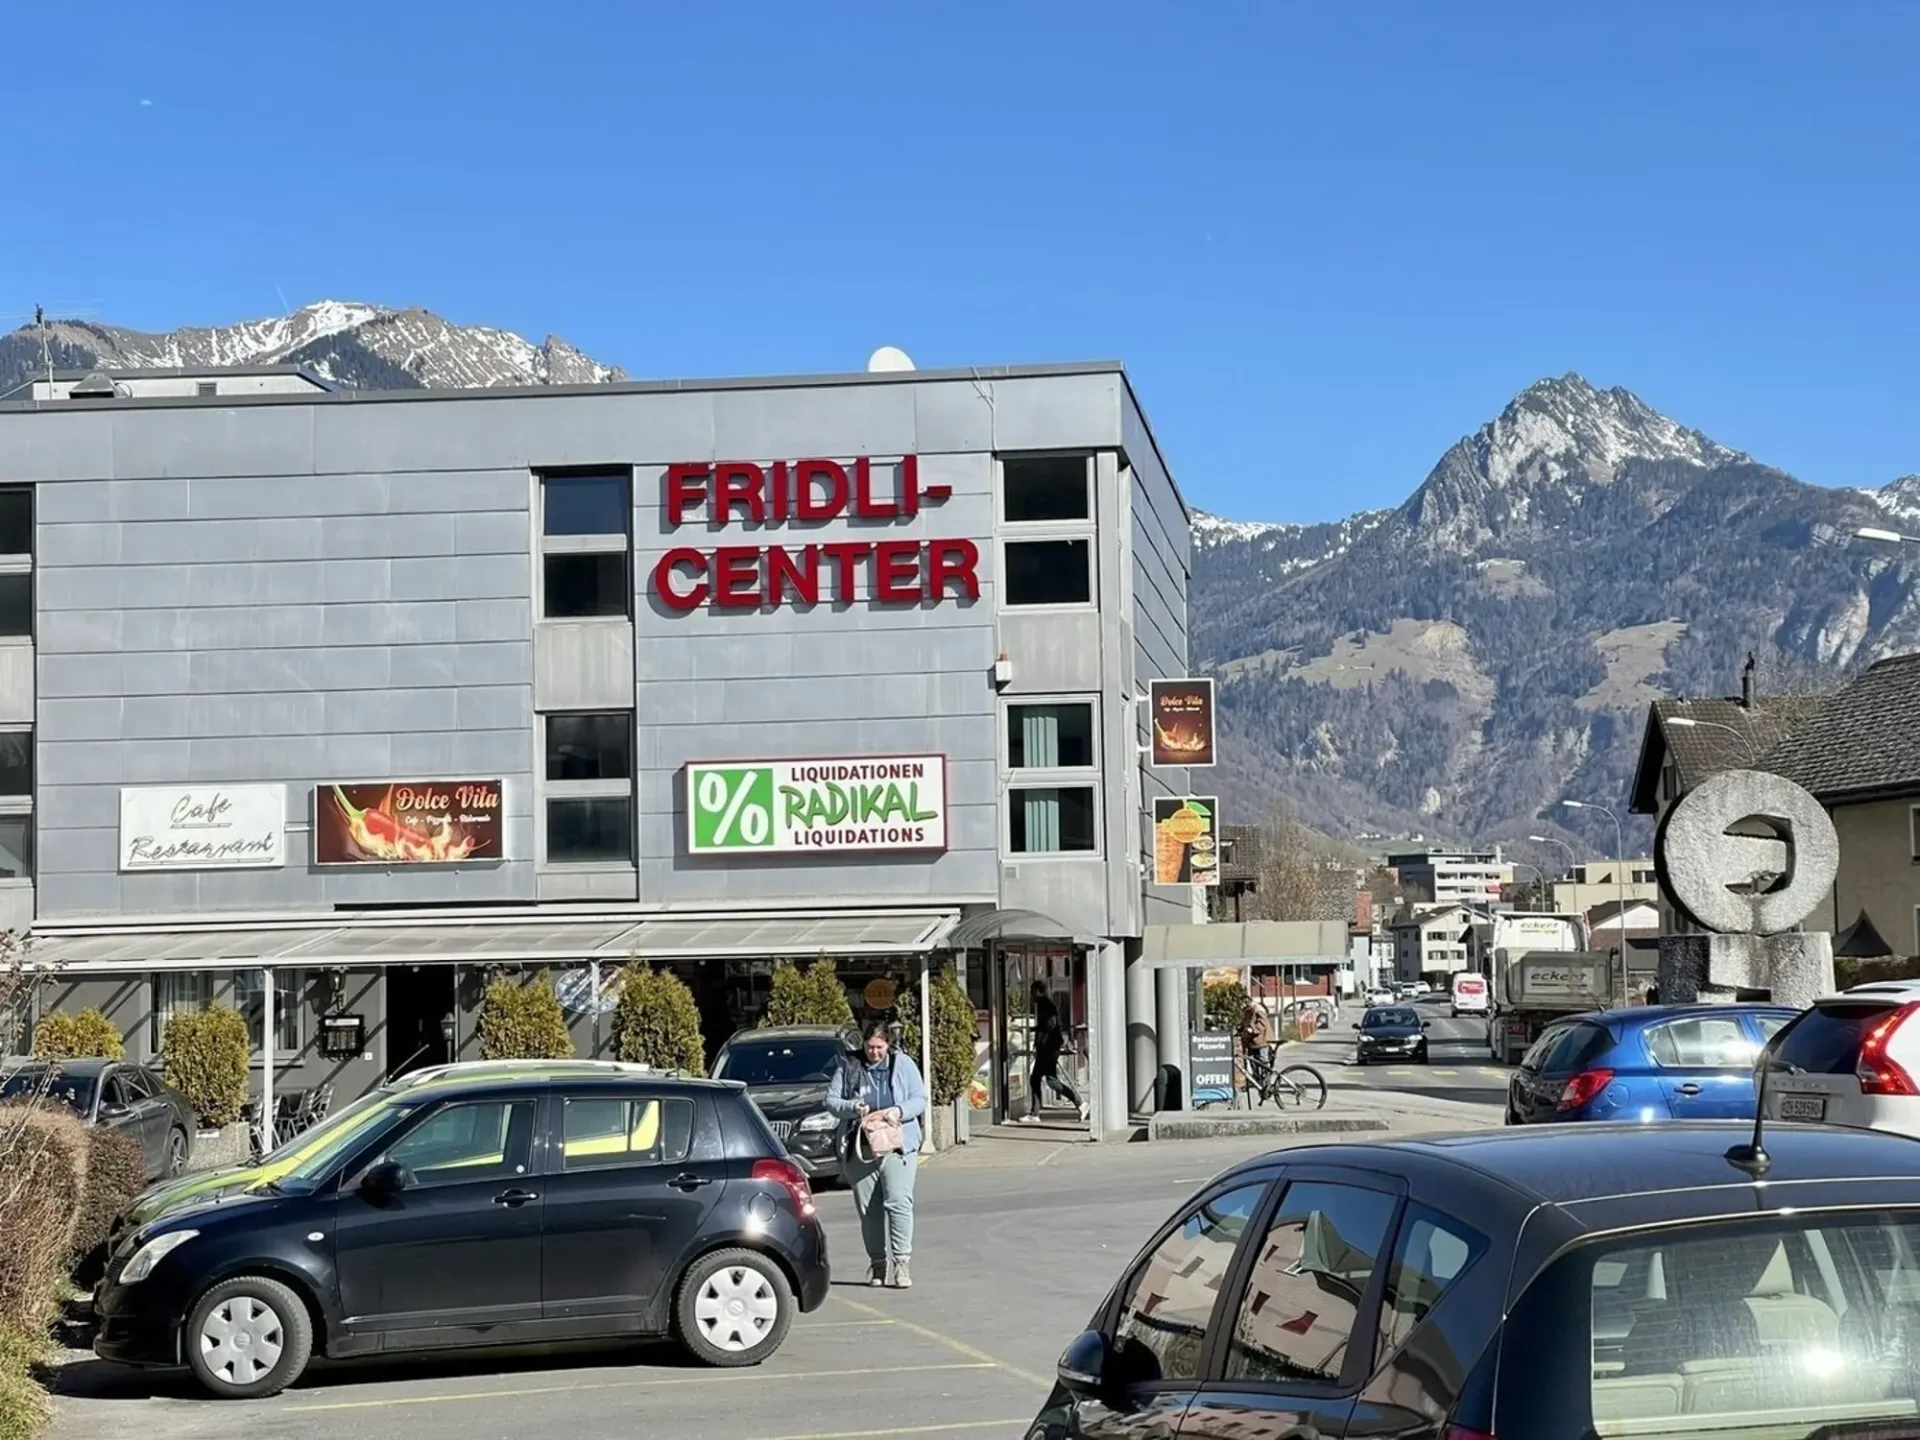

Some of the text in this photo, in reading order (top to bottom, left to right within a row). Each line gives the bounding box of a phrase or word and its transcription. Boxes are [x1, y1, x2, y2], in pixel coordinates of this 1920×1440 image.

[667, 454, 952, 525] FRIDLI-
[655, 538, 981, 610] CENTER
[791, 764, 924, 782] LIQUIDATIONEN
[396, 785, 500, 811] Dolce Vita
[779, 781, 938, 829] RADIKAL
[129, 831, 274, 861] Restaurant
[794, 827, 924, 847] LIQUIDATIONS
[1196, 1074, 1230, 1085] OFFEN
